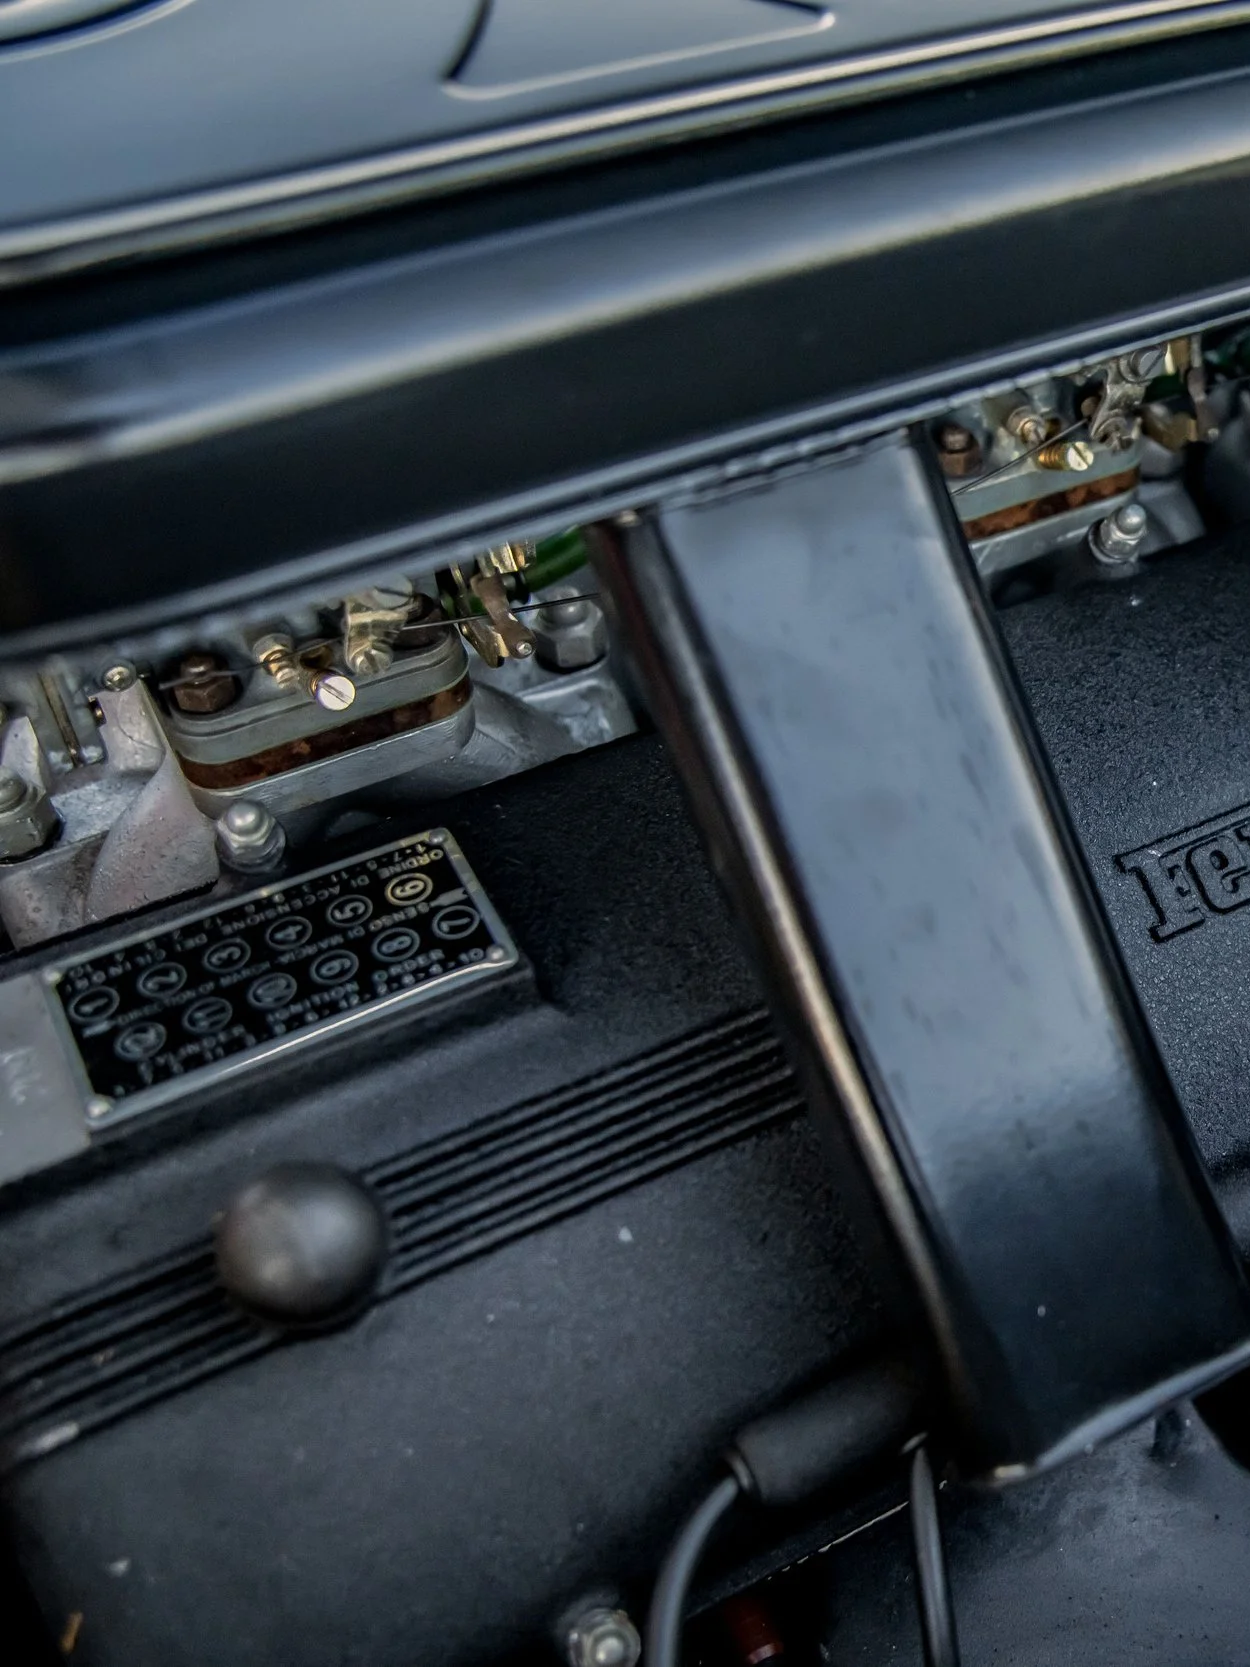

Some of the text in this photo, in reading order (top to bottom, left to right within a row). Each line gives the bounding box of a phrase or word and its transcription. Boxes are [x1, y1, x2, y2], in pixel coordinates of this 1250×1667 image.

[377, 848, 444, 879] ORDINE
[350, 875, 369, 888] DI
[221, 885, 341, 935] ACCENSIONE
[367, 901, 429, 932] SENSO
[347, 925, 365, 939] DI
[266, 981, 359, 1024] IGNITION
[371, 949, 444, 983] ORDER
